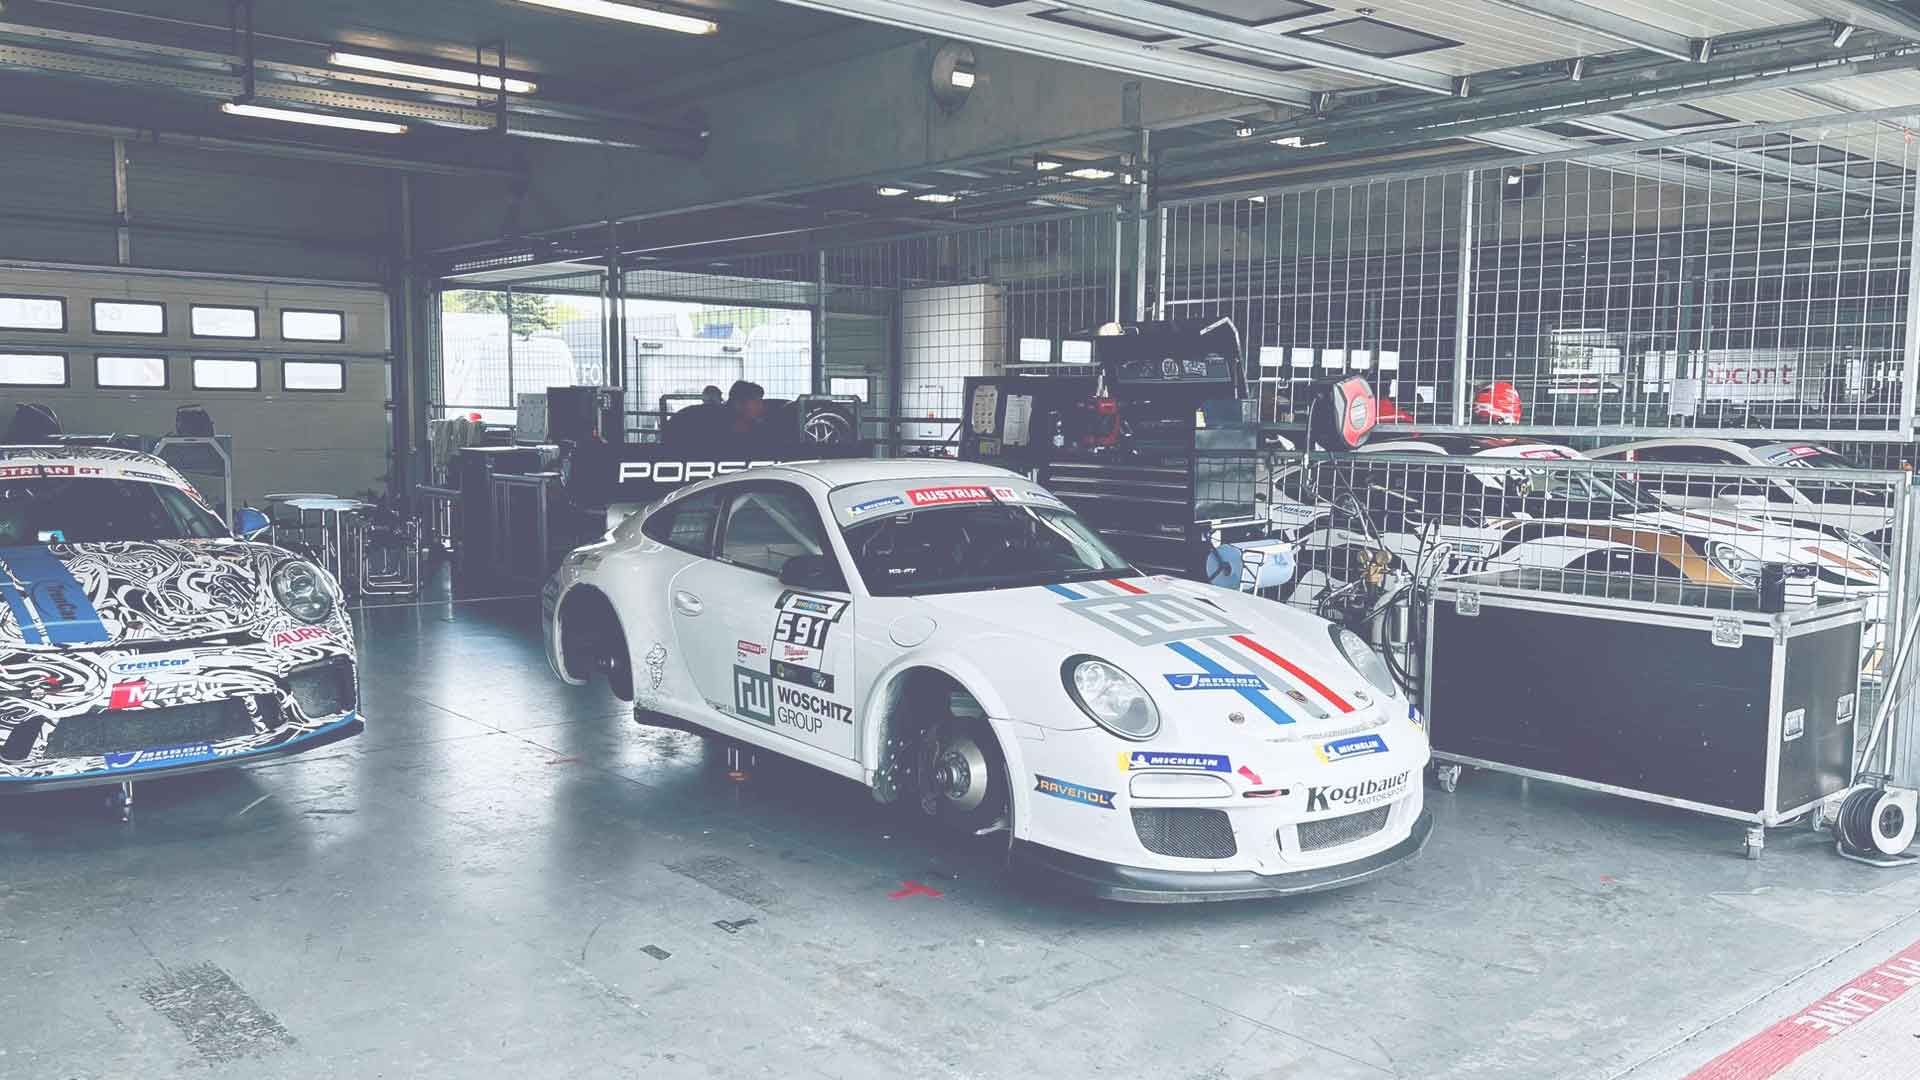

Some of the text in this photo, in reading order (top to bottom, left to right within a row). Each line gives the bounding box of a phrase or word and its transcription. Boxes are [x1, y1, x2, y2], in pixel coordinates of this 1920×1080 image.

[619, 461, 782, 483] PORS
[775, 612, 824, 648] 591
[117, 659, 190, 671] TrenCar
[777, 685, 853, 724] WOSCHITZ
[778, 706, 823, 733] GROUP
[1338, 740, 1380, 755] MICHELIN
[1149, 756, 1219, 767] MICHELIN
[1039, 779, 1109, 805] RAVENOL
[1306, 769, 1411, 813] Koglbauer
